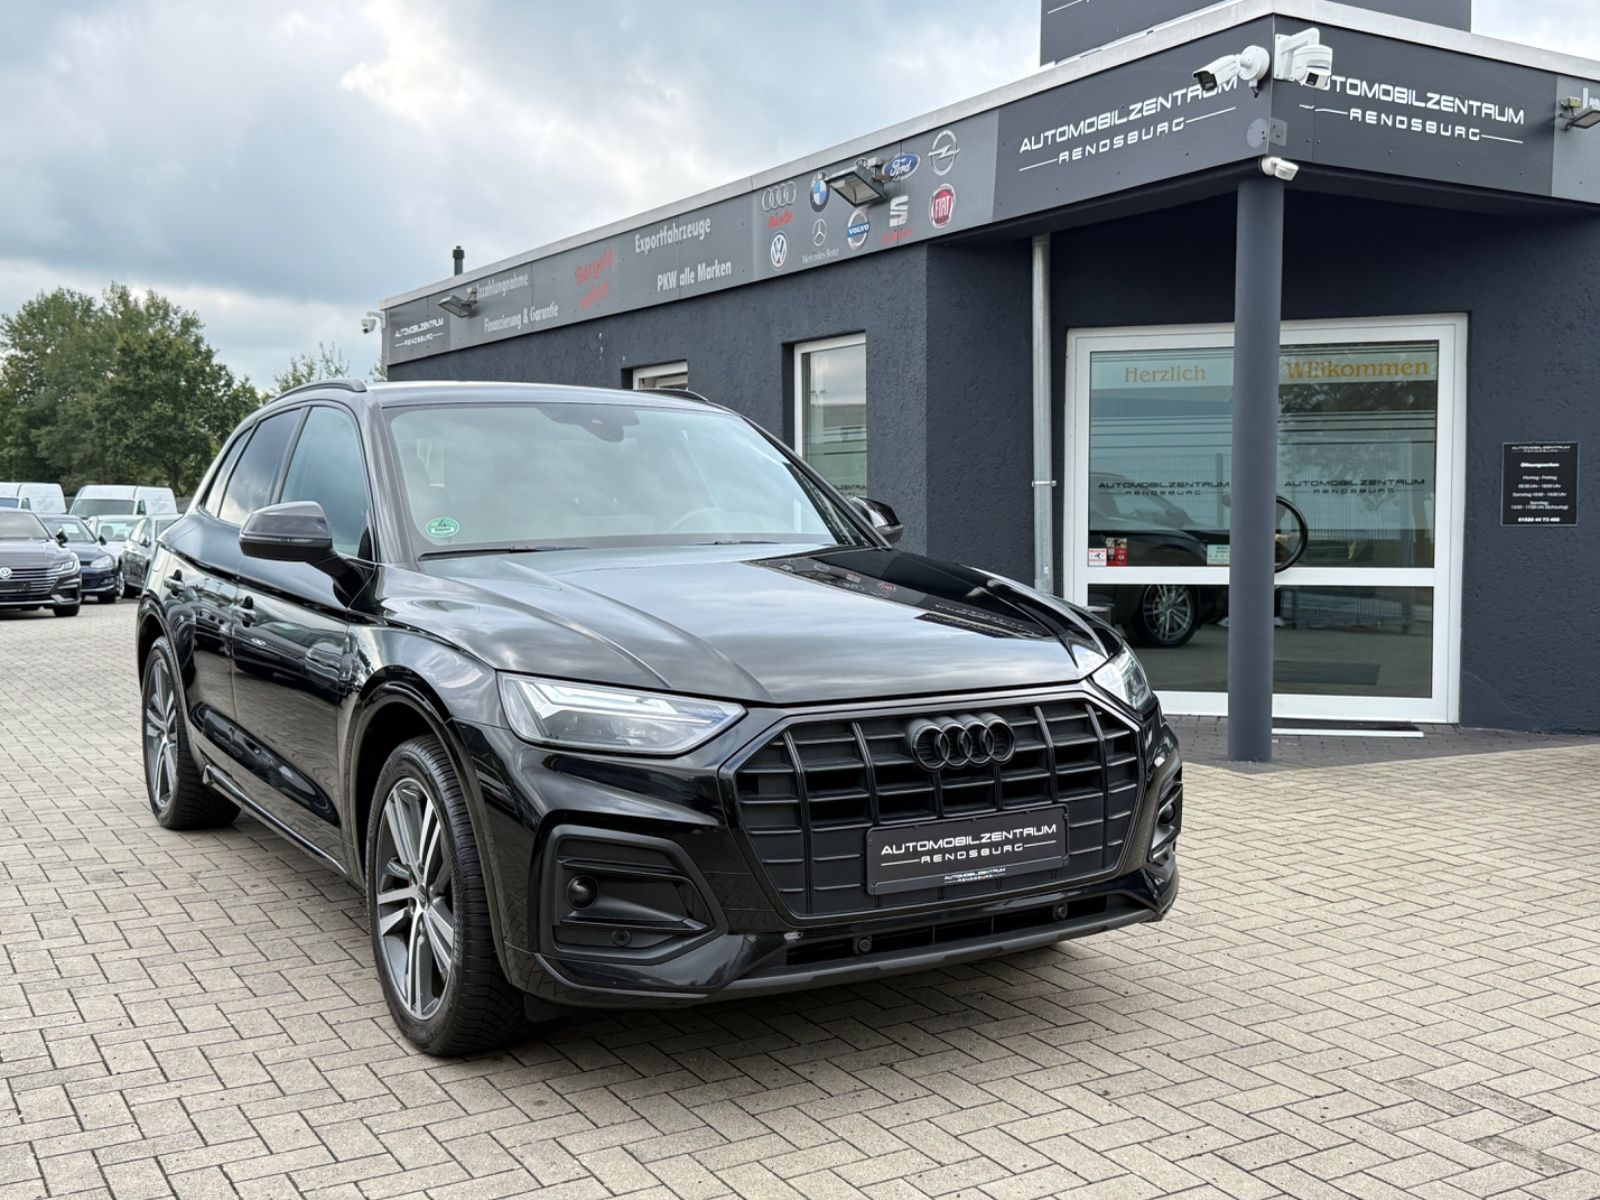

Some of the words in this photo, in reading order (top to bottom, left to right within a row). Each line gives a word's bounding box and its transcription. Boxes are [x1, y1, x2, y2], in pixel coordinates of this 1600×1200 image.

[1300, 75, 1525, 125] TOMOBILZENTRUM
[1349, 108, 1480, 142] RENDSBURG
[1058, 117, 1185, 164] RENDSBURG
[934, 195, 951, 220] FIAT
[634, 218, 711, 254] Exportfahrzeuge
[848, 224, 869, 236] VOLVO
[657, 270, 677, 292] PKW
[680, 266, 695, 285] alle
[697, 259, 732, 282] Marken
[483, 314, 522, 334] Finanzierung
[523, 307, 529, 324] &
[530, 301, 559, 322] Garantie
[1123, 364, 1206, 384] Herzlich
[1285, 359, 1429, 380] Willkommen
[1098, 481, 1231, 490] AUTOMOBILZENTRUM
[1124, 489, 1203, 497] RENDSBURG
[1285, 478, 1426, 488] AUTOMOBILZENTRUM
[1313, 487, 1396, 495] RENDSBURG
[880, 824, 1057, 855] AUTOMOBILZENTRUM
[920, 843, 1024, 864] RENDSBURG
